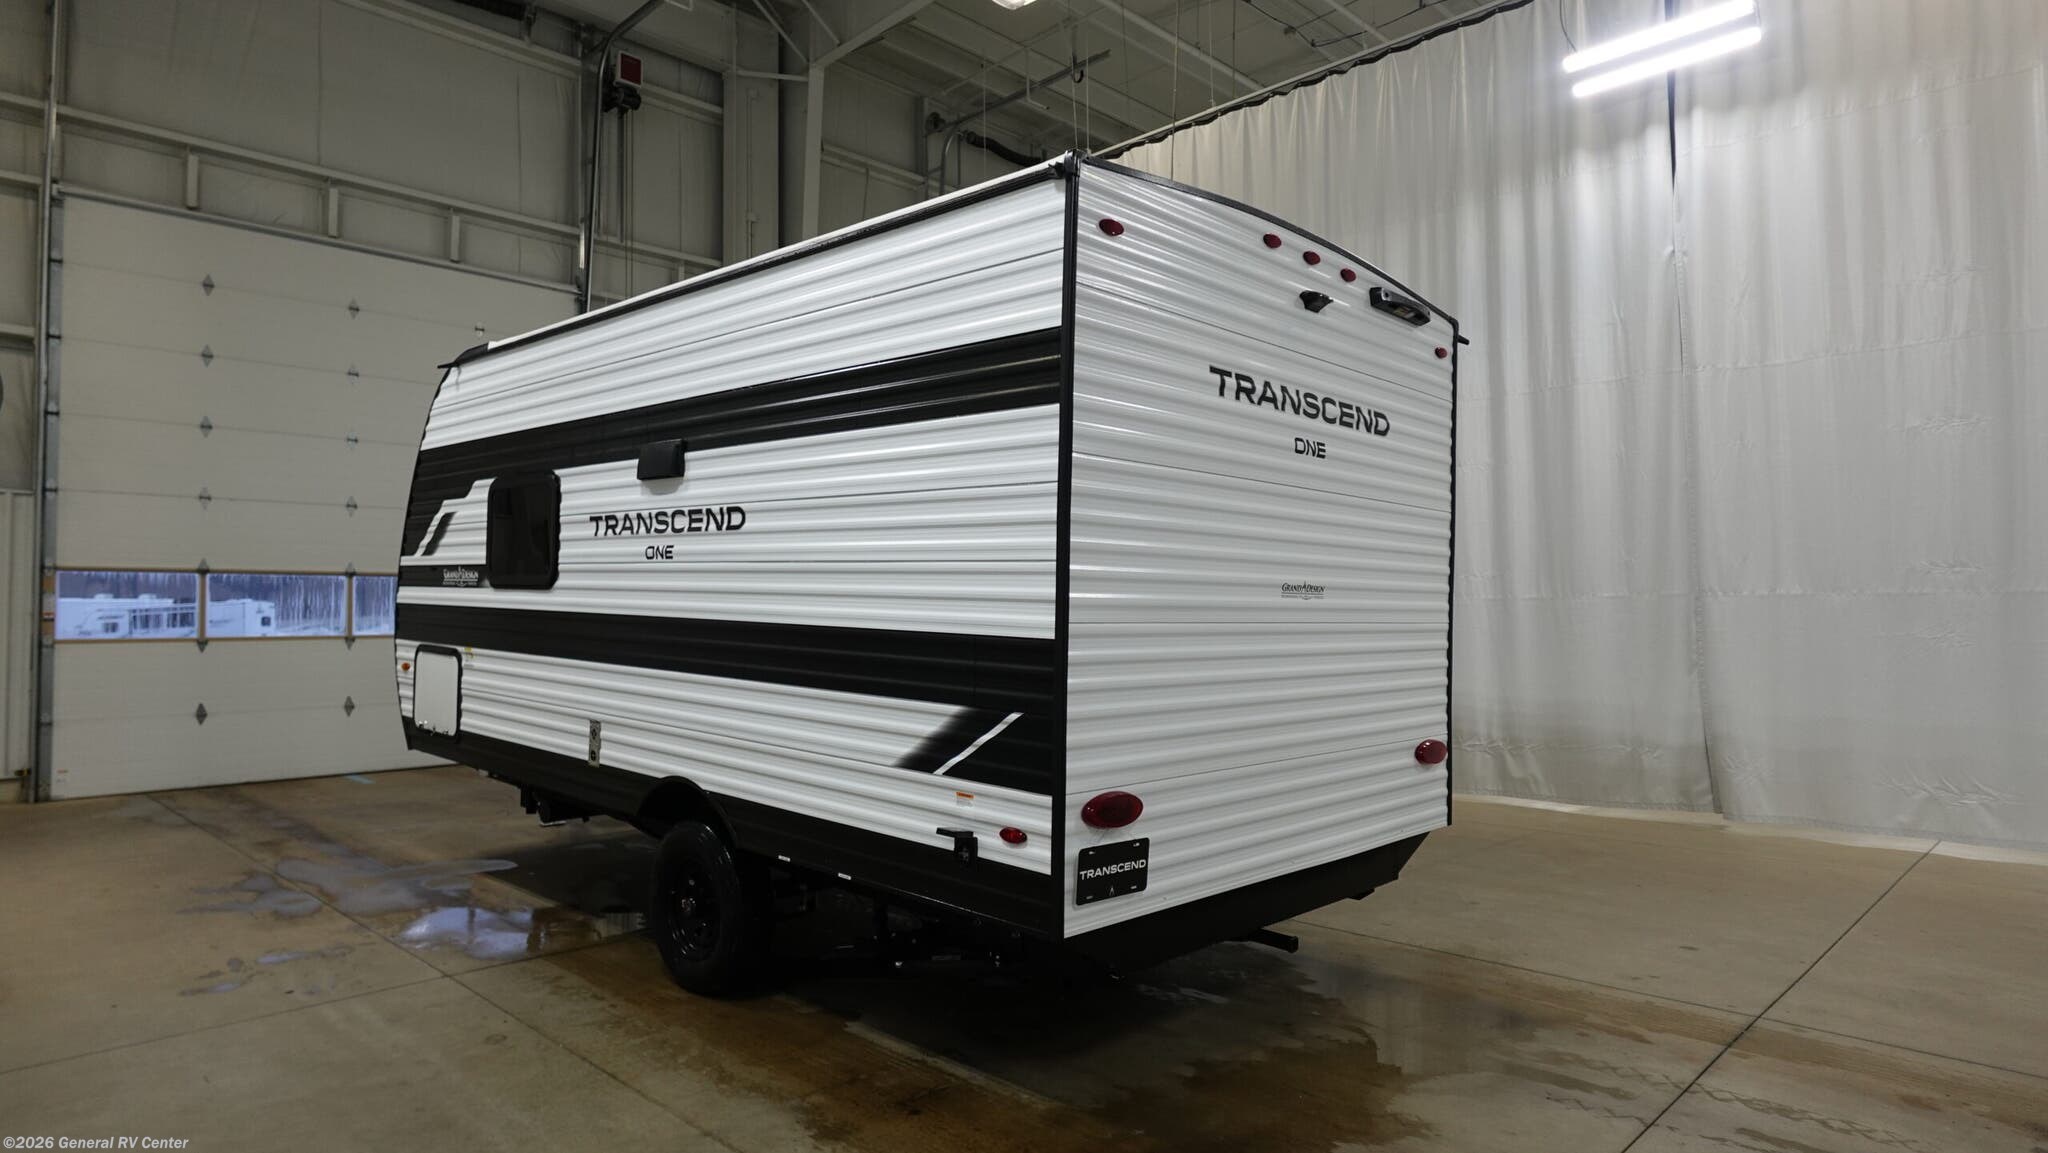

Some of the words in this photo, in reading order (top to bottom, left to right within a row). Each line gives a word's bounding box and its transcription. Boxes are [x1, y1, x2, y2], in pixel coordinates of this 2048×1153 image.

[1209, 364, 1391, 437] TRANSCEND
[1294, 437, 1326, 459] ONE
[589, 506, 746, 537] TRANSCEND
[645, 545, 675, 560] ONE
[1080, 859, 1147, 881] TRANSCEND
